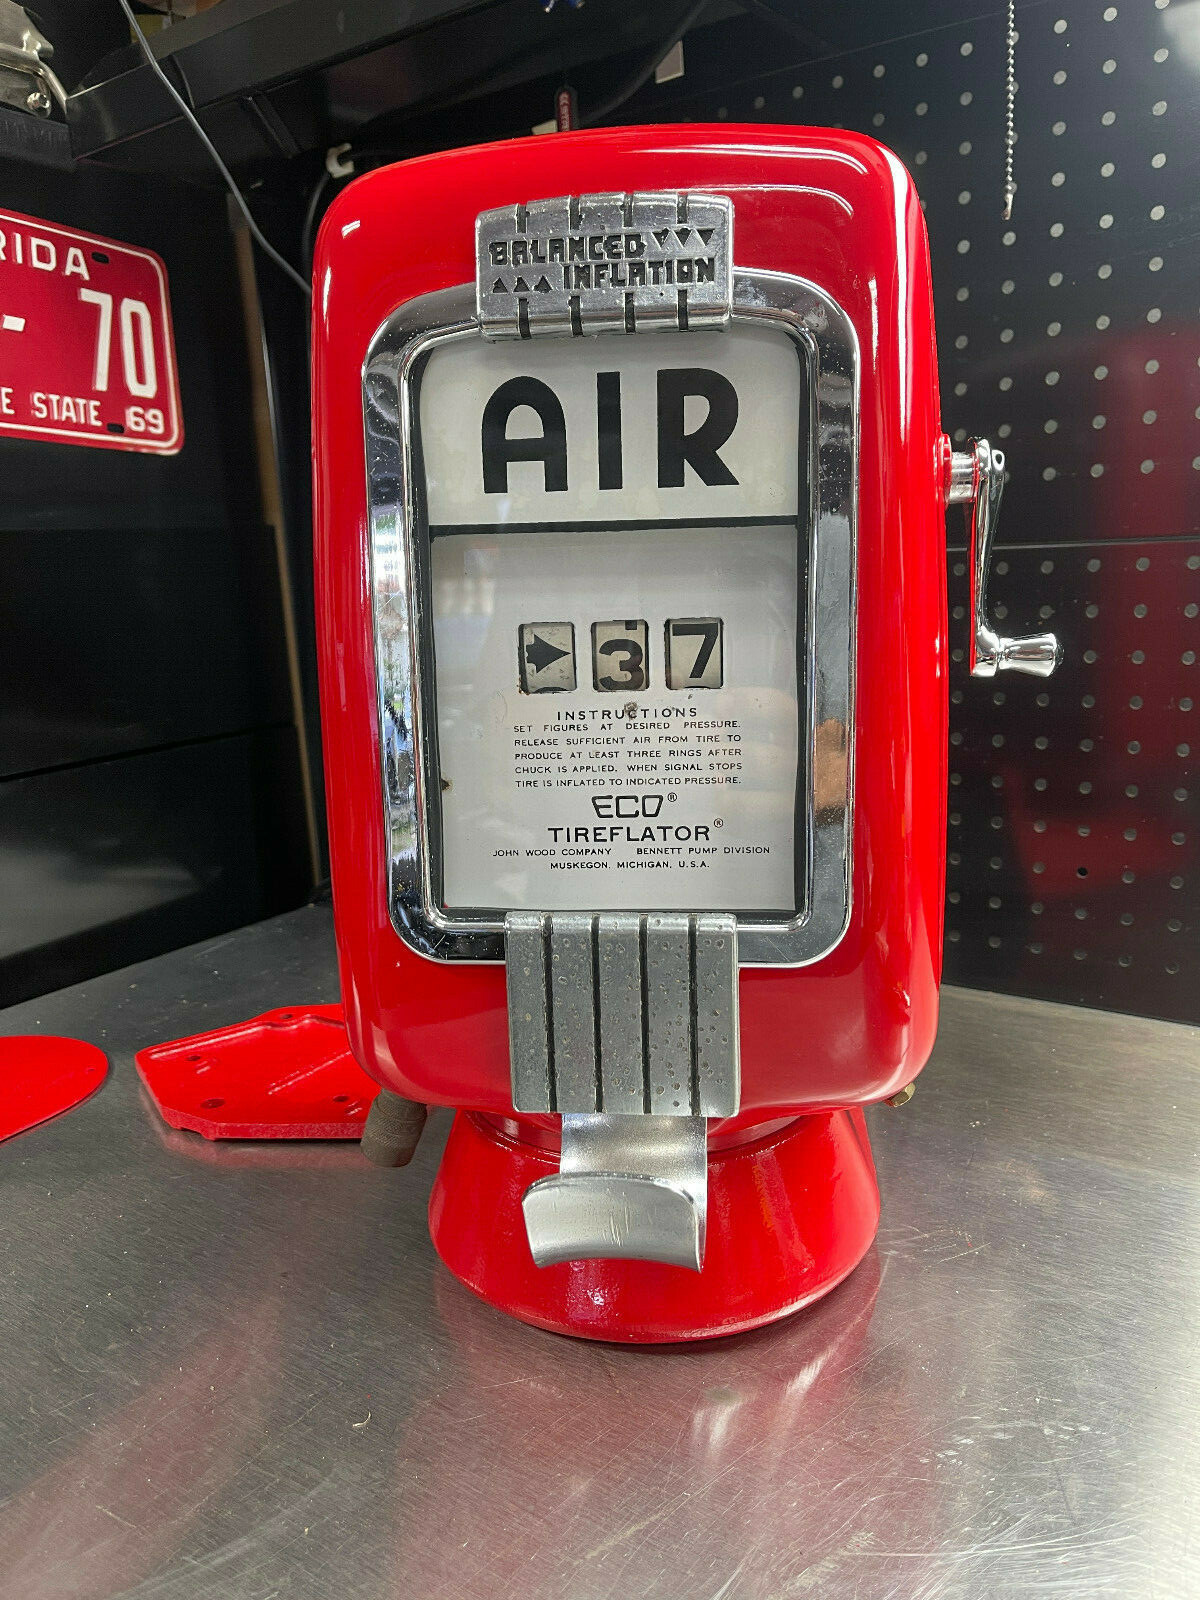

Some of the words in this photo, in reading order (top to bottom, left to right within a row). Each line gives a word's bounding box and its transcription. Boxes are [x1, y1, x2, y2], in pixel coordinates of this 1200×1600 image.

[489, 233, 647, 265] BALANCED
[563, 258, 715, 290] INFLATION
[31, 392, 103, 426] STATE
[126, 405, 164, 435] 69
[482, 368, 739, 493] AIR
[556, 708, 698, 720] INSTRUCTIONS
[544, 724, 588, 732] FIGURES
[626, 722, 670, 730] DESIRED
[566, 737, 625, 745] SUFFICIENT
[669, 749, 702, 757] RINGS
[665, 763, 702, 771] SIGNAL
[562, 848, 612, 856] COMPANY
[724, 846, 770, 854] DIVISION
